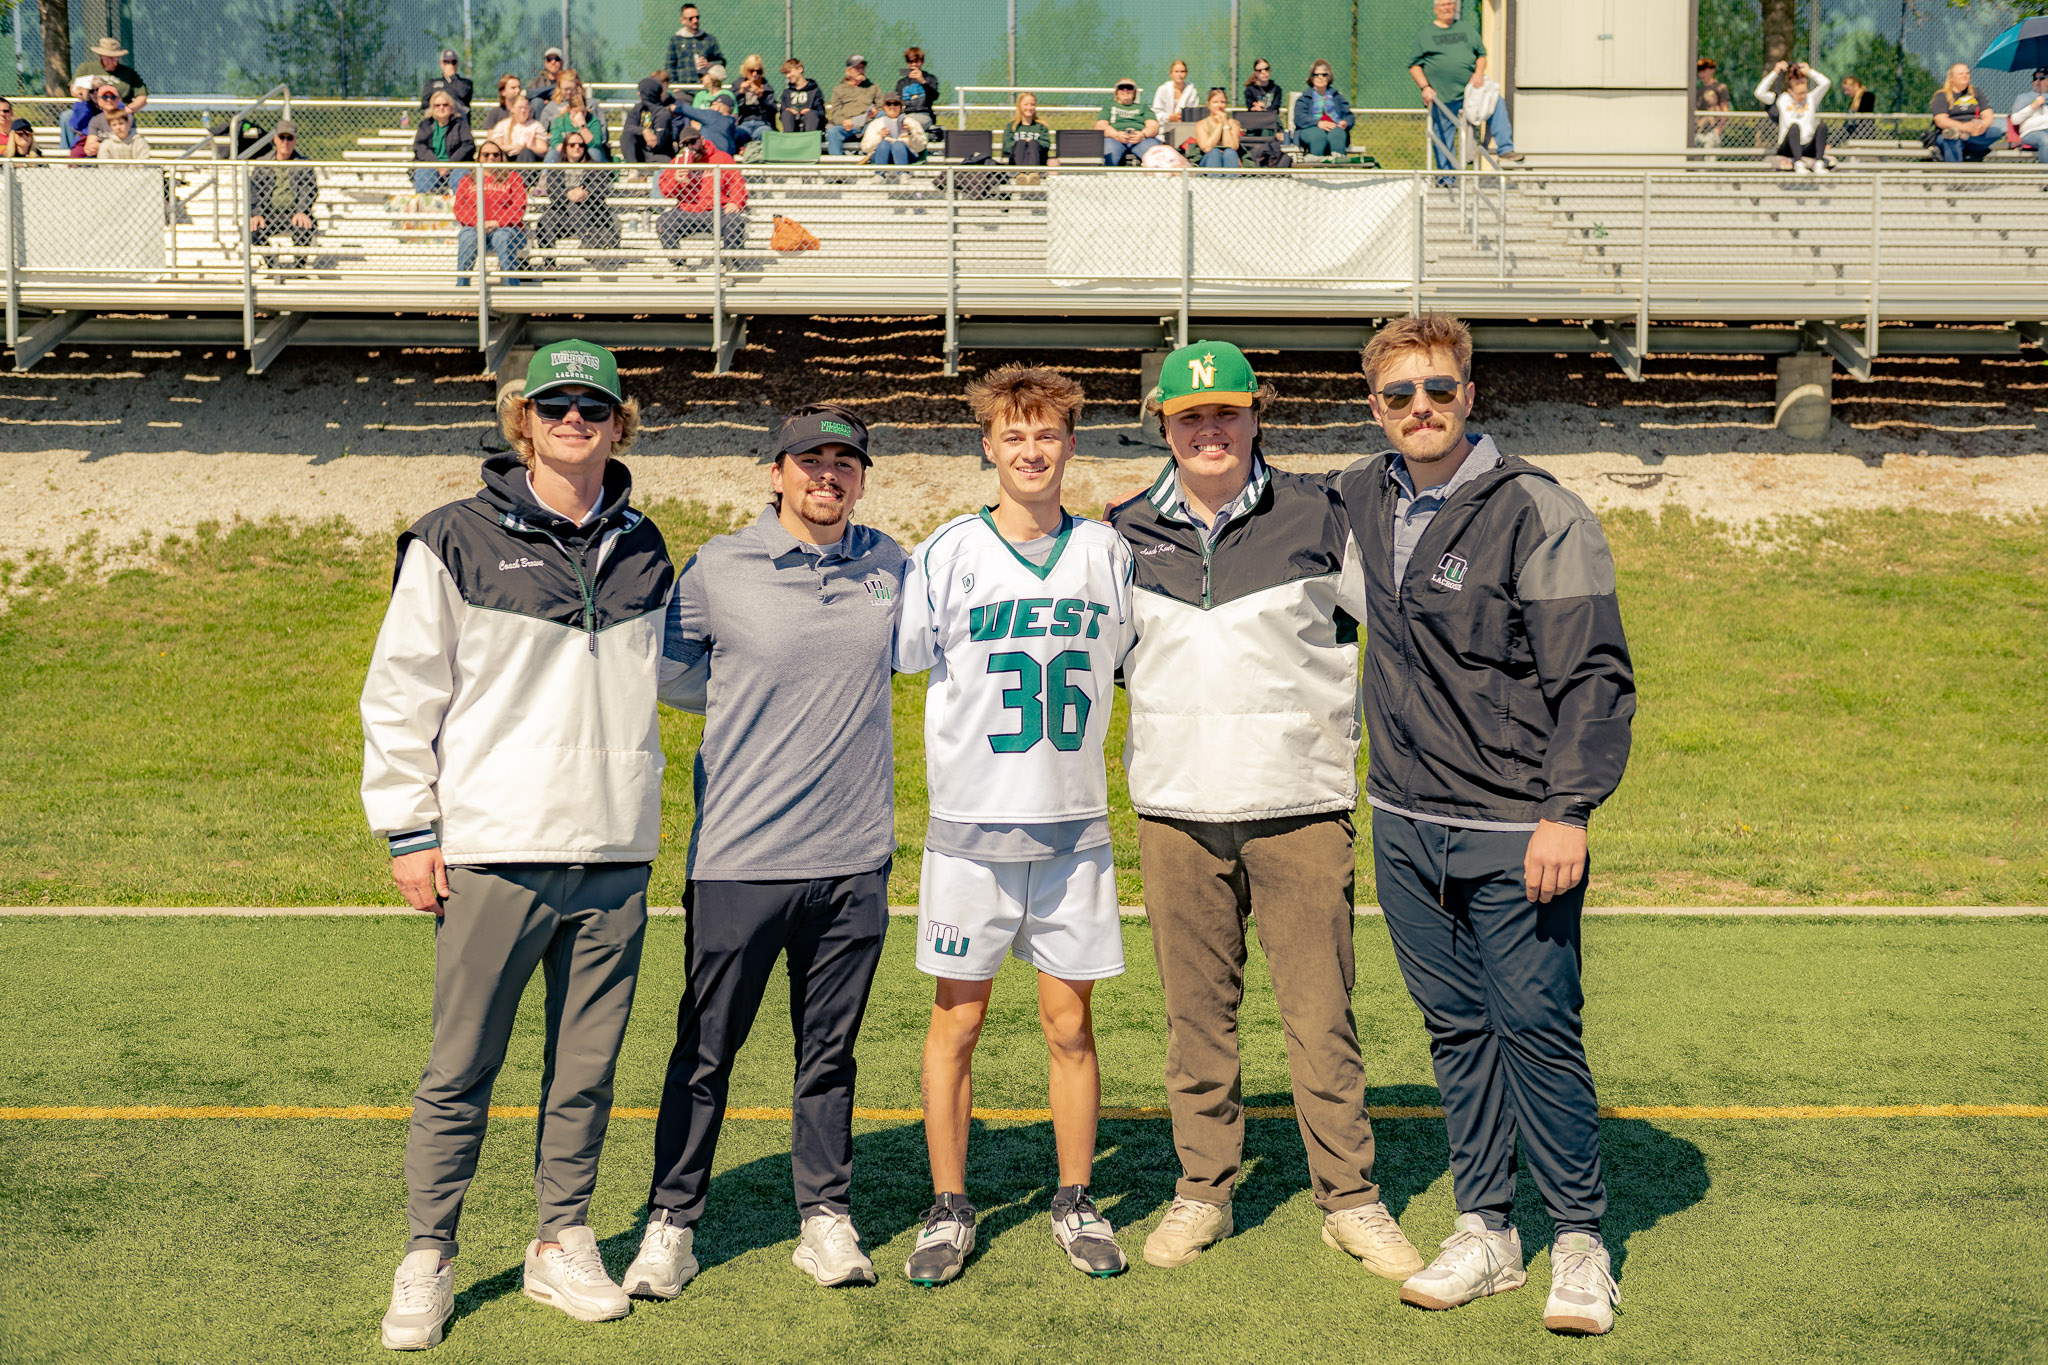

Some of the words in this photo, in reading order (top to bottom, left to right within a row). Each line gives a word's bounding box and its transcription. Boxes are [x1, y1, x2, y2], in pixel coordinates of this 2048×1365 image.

[551, 352, 599, 371] WILDCATS
[555, 371, 594, 381] LACROSSE
[1188, 359, 1217, 390] N
[498, 558, 520, 571] Coach
[1431, 573, 1463, 591] LACROSSE
[969, 598, 1110, 642] WEST
[986, 650, 1092, 753] 36
